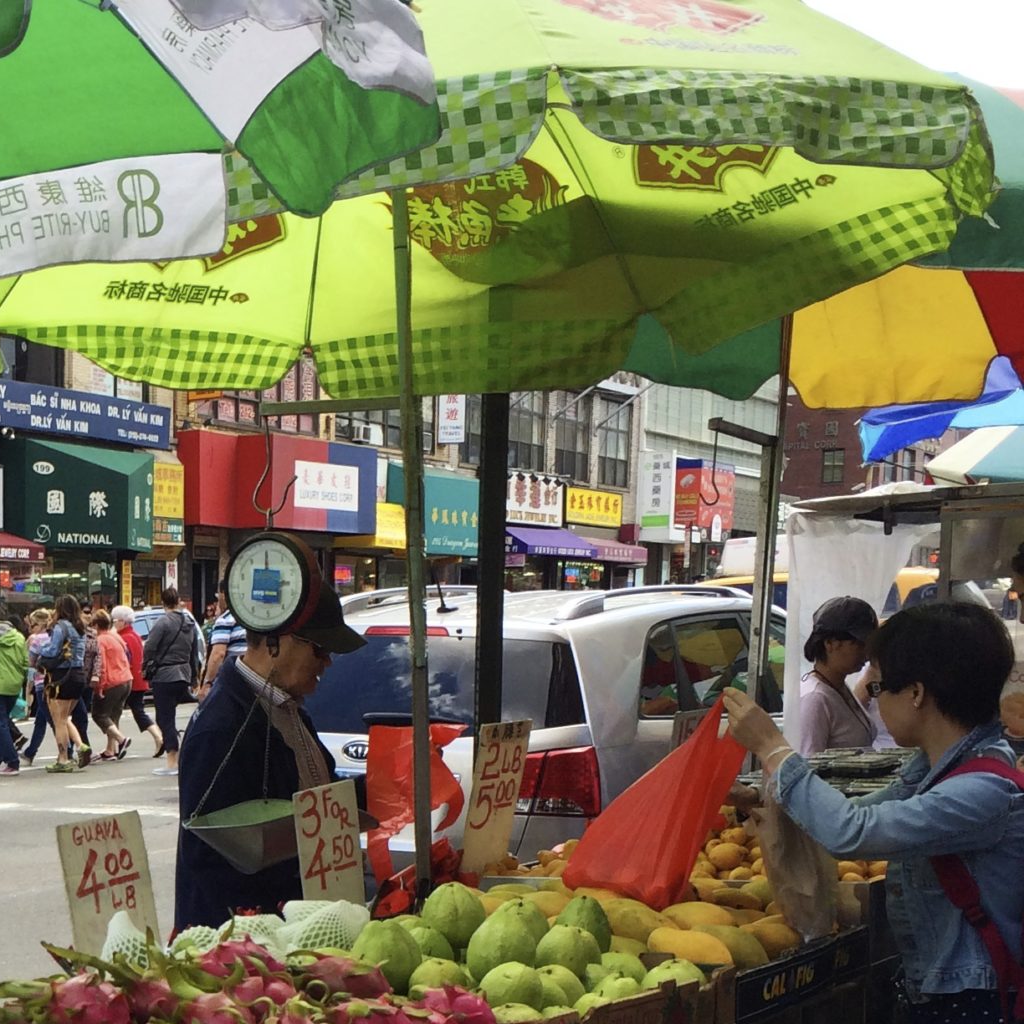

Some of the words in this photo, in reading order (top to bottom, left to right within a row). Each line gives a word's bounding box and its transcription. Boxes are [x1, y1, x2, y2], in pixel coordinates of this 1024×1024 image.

[30, 390, 47, 407] BÁC
[61, 397, 77, 412] NHA
[80, 400, 101, 415] KHOA
[107, 405, 120, 418] DR.
[122, 403, 131, 420] LÝ
[150, 414, 163, 426] KIM
[74, 421, 89, 434] KIM
[35, 464, 51, 473] 199
[58, 532, 113, 545] NATIONAL
[300, 790, 321, 839] 3
[321, 788, 355, 831] FOR
[72, 818, 124, 846] GUAVA
[111, 884, 136, 910] LB
